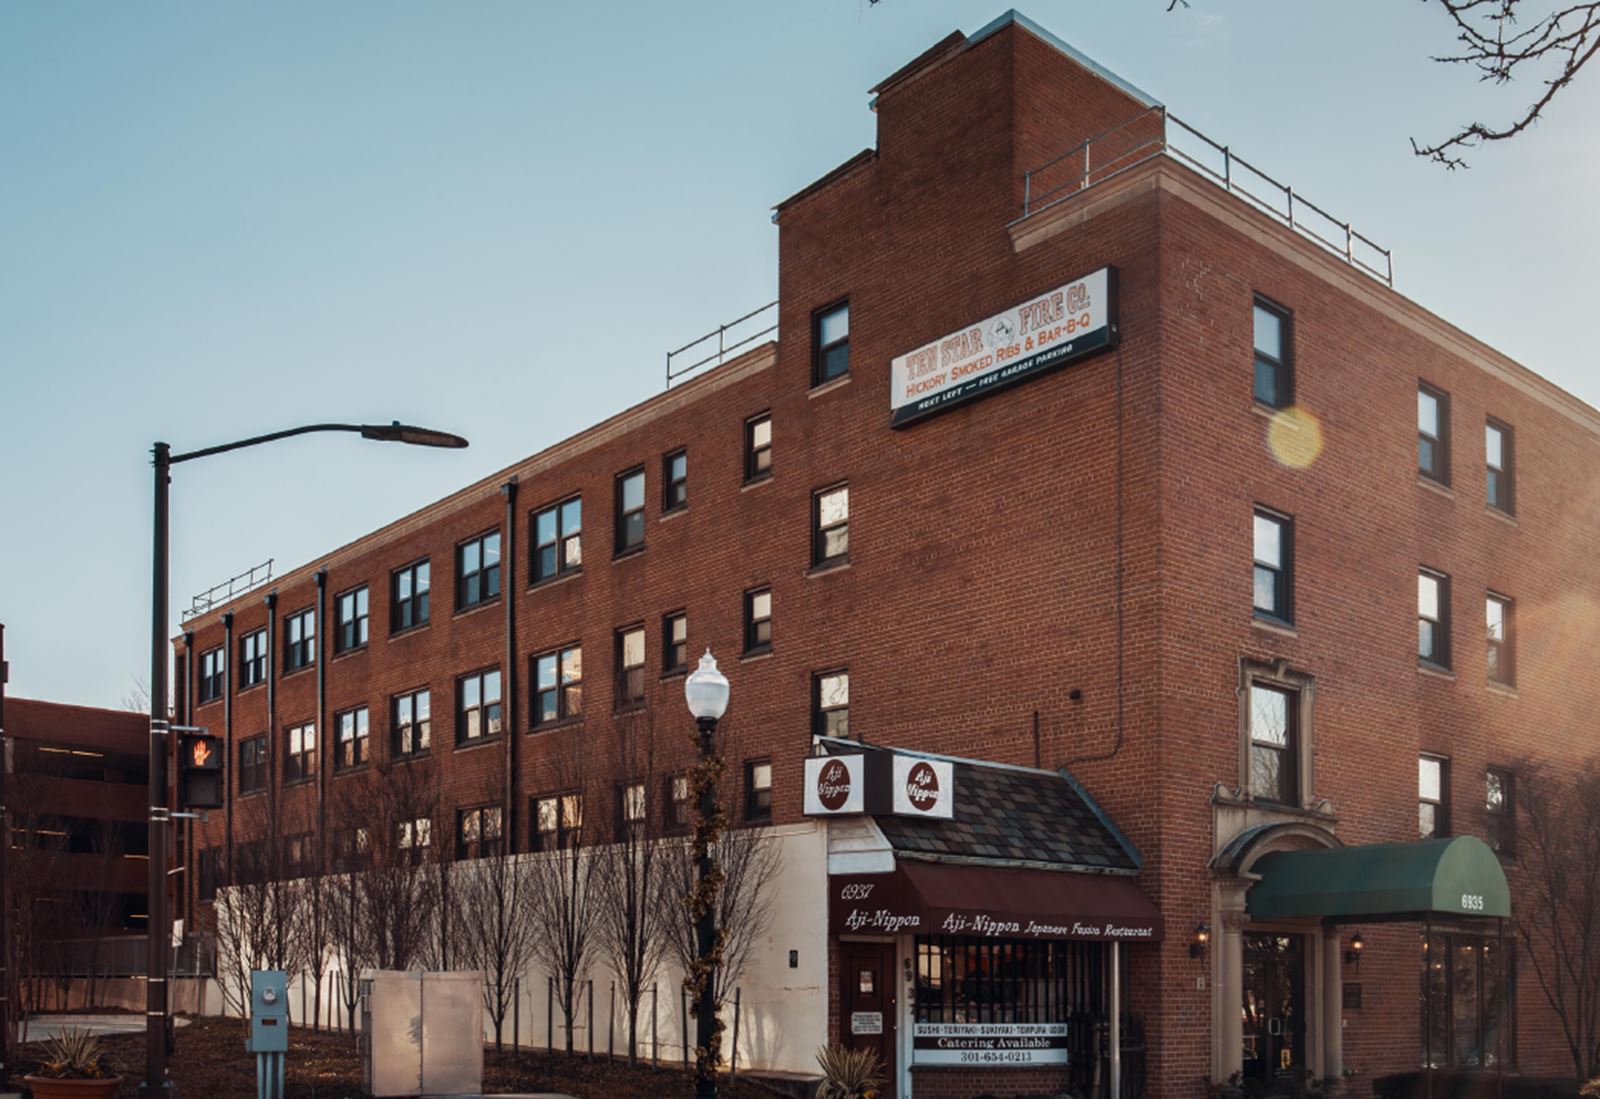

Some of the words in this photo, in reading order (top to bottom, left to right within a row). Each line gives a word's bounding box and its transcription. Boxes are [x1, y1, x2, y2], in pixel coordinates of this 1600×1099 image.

[905, 345, 938, 380] TEN
[941, 328, 984, 368] STAR
[1019, 292, 1065, 336] FIRE
[906, 373, 947, 398] HICKORY
[951, 354, 993, 381] SMOKED
[996, 343, 1021, 363] RIBS
[1025, 336, 1035, 351] &
[1038, 312, 1090, 346] BAR-B-Q
[942, 386, 963, 401] LEFT
[1036, 343, 1073, 365] PARKING
[826, 765, 843, 782] Aji
[915, 769, 932, 785] Aji
[818, 781, 850, 798] Nippon
[906, 783, 940, 801] Nippon
[841, 884, 874, 900] 6937
[1461, 894, 1484, 910] 6935
[845, 909, 920, 932] Aji-Nippon
[942, 912, 1020, 936] Aji-Nippon
[1024, 920, 1068, 936] Japanese
[1104, 924, 1153, 937] Restaurant
[937, 1037, 994, 1049] Catering
[997, 1037, 1051, 1048] Available
[960, 1051, 1032, 1063] 301-654-0213
